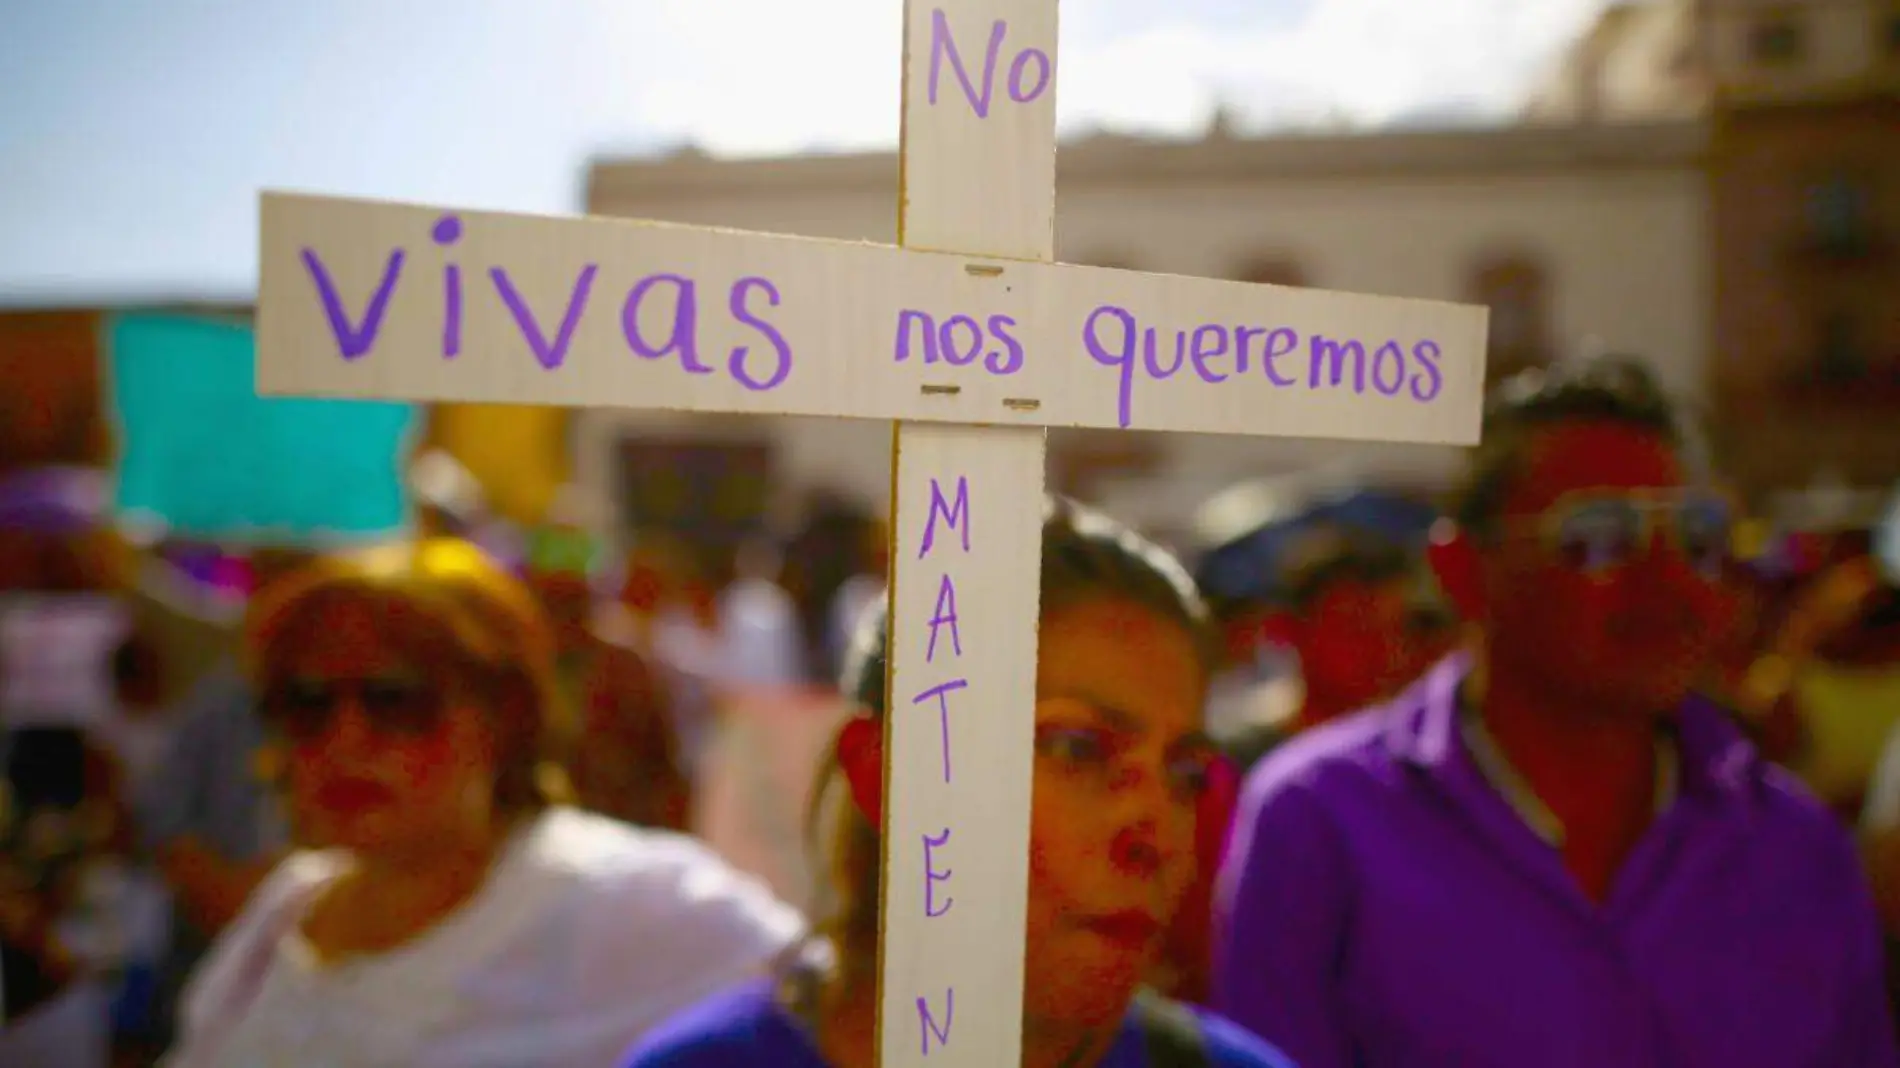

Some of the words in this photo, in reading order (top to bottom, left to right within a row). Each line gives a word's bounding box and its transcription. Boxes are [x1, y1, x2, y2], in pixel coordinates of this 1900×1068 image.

[928, 8, 1051, 119] No
[893, 308, 1025, 376] nos
[1082, 304, 1443, 428] queremos
[911, 475, 972, 1056] MATEN
